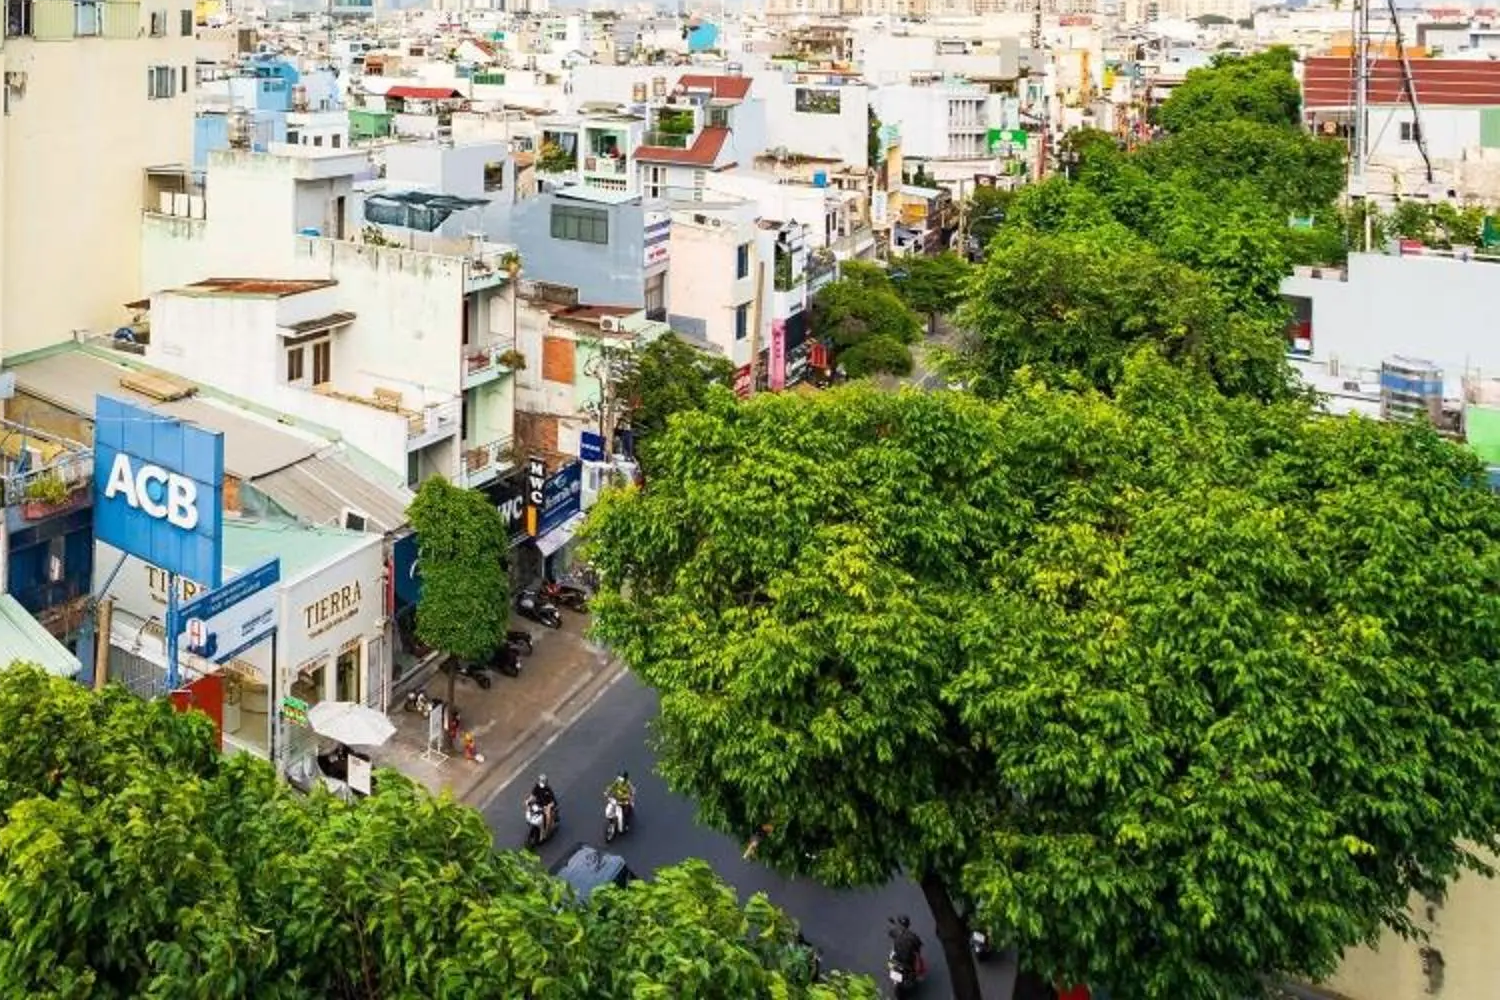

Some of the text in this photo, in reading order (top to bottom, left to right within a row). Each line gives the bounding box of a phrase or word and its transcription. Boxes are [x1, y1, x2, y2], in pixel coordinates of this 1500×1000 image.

[105, 452, 198, 530] ACB
[530, 461, 545, 504] MWC
[304, 579, 361, 628] TIERRA
